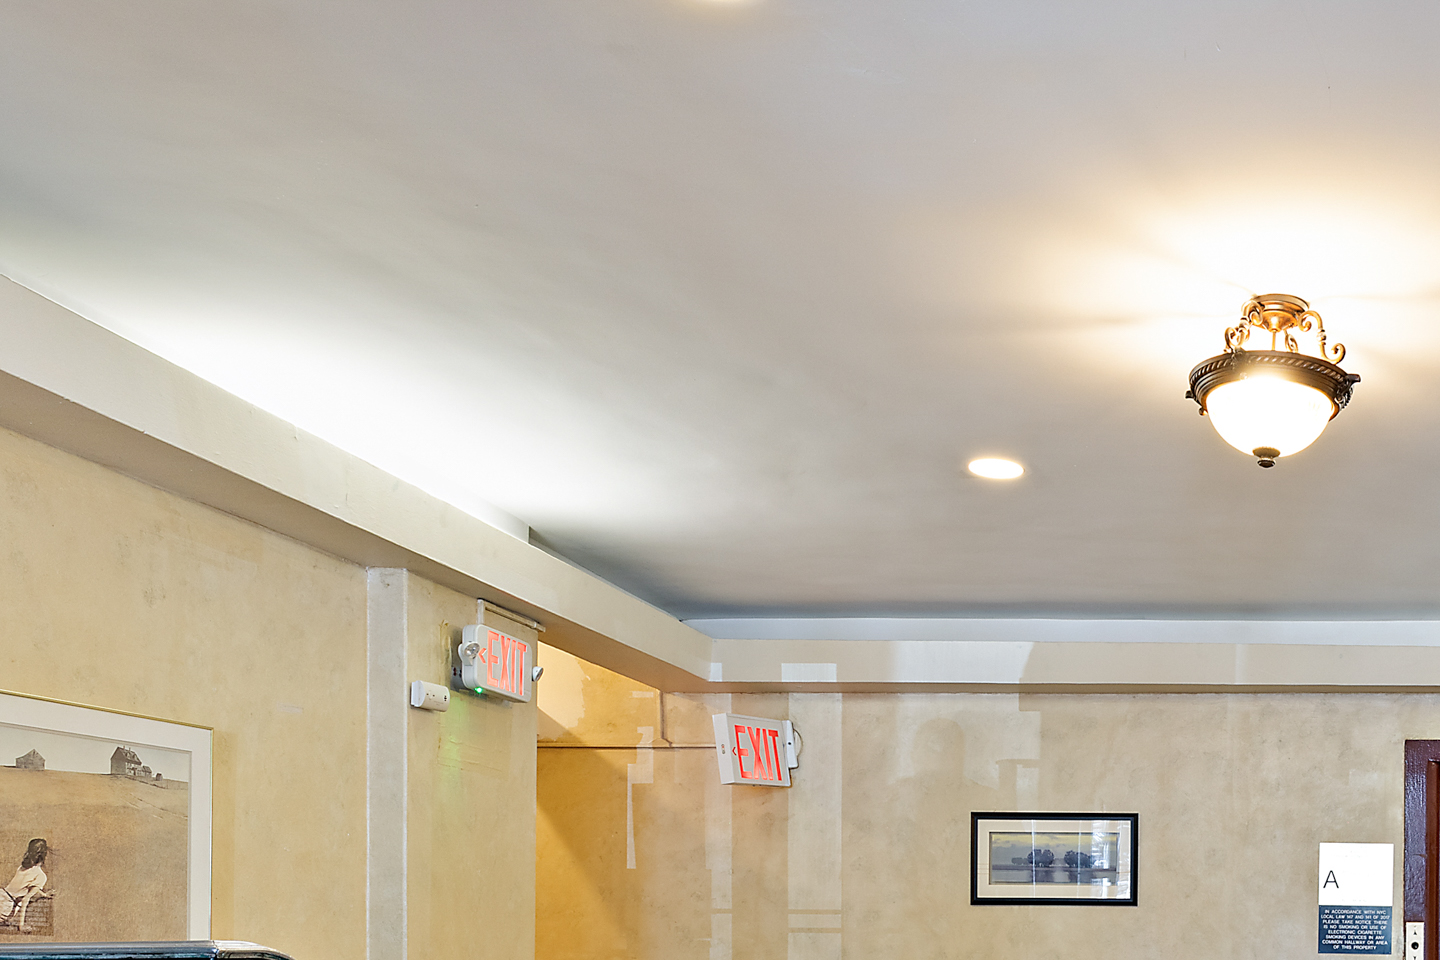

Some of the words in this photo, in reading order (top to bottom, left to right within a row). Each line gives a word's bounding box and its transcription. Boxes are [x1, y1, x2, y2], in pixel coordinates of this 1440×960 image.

[486, 630, 527, 696] EXIT
[734, 724, 783, 782] EXIT
[1323, 870, 1339, 888] A
